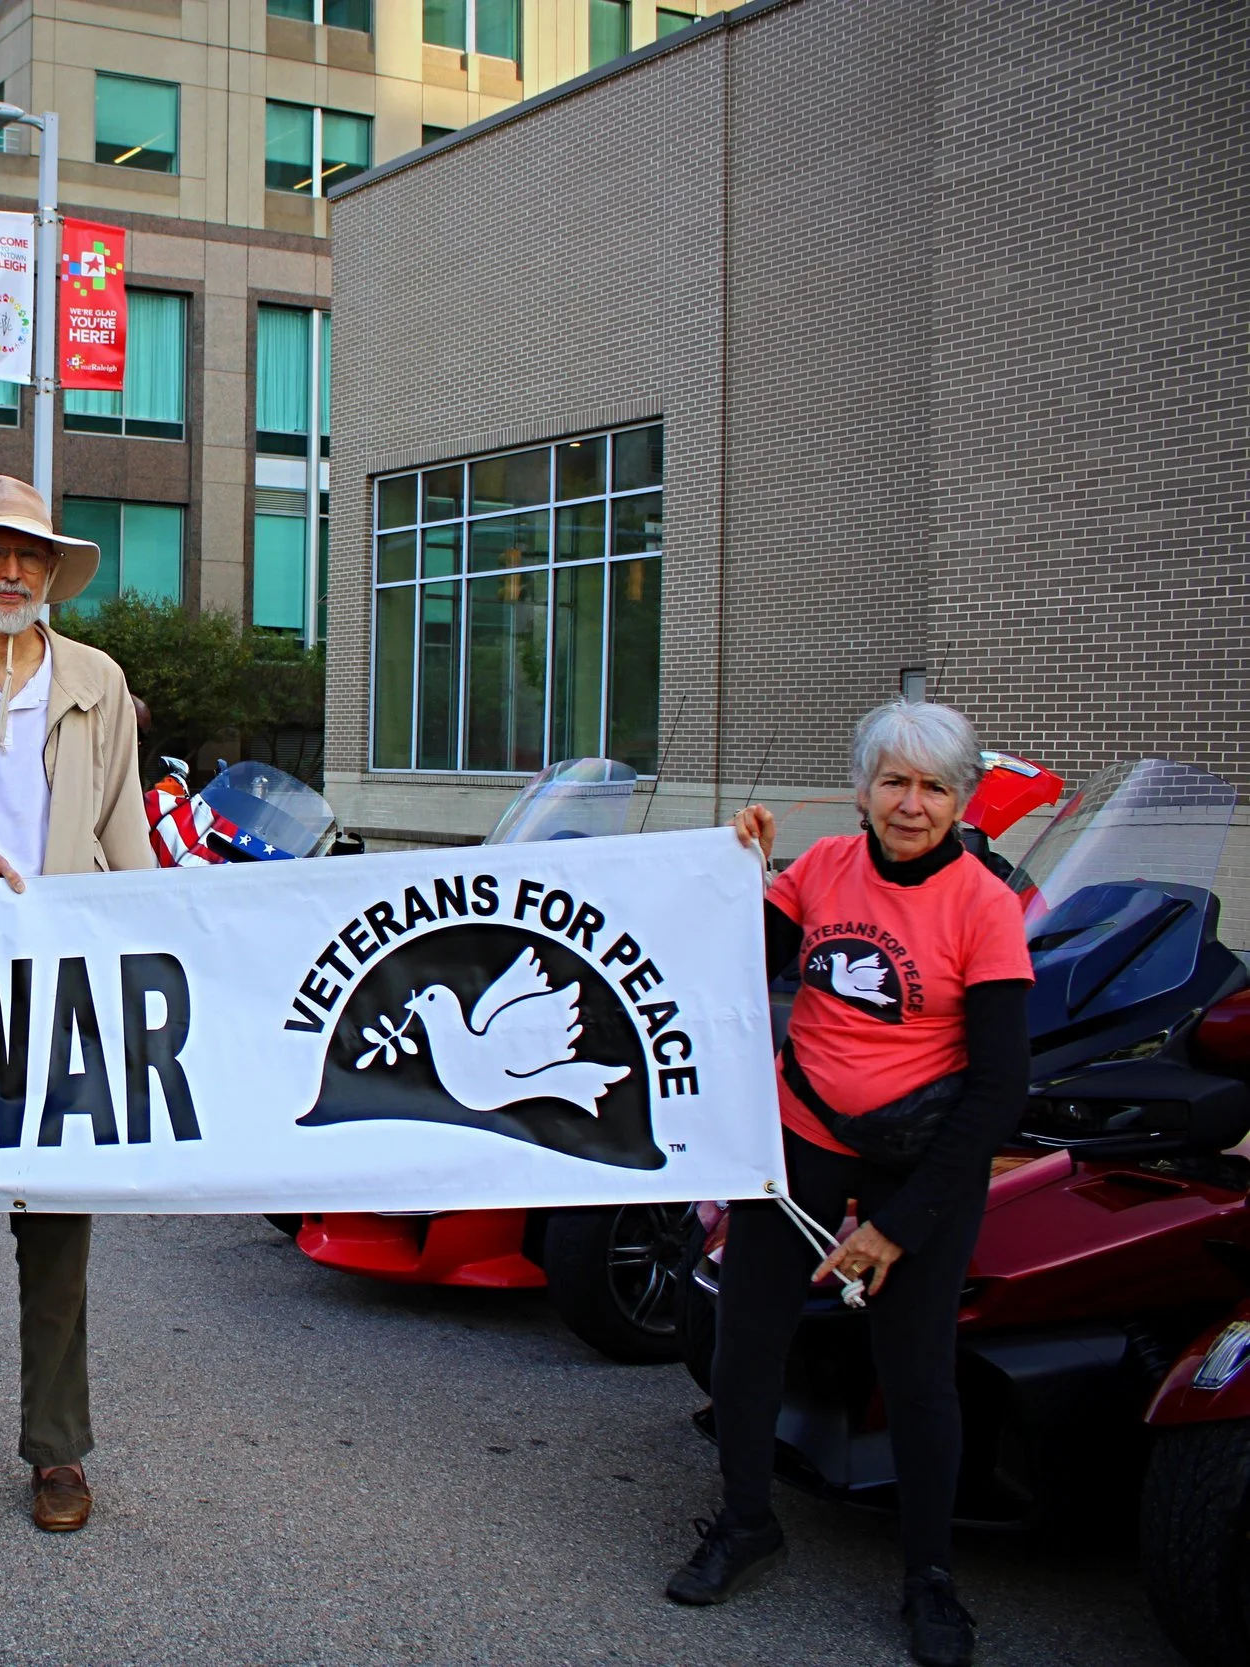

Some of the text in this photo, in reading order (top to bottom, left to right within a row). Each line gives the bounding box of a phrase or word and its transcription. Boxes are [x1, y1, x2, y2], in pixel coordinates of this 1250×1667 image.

[69, 307, 118, 317] WE'RE GLAD
[69, 315, 117, 329] YOU'RE
[69, 328, 116, 345] HERE!
[80, 363, 118, 373] Raleigh
[877, 931, 907, 960] FOR
[900, 959, 925, 1013] PEACE
[283, 873, 700, 1100] VETERANS FOR PEACE
